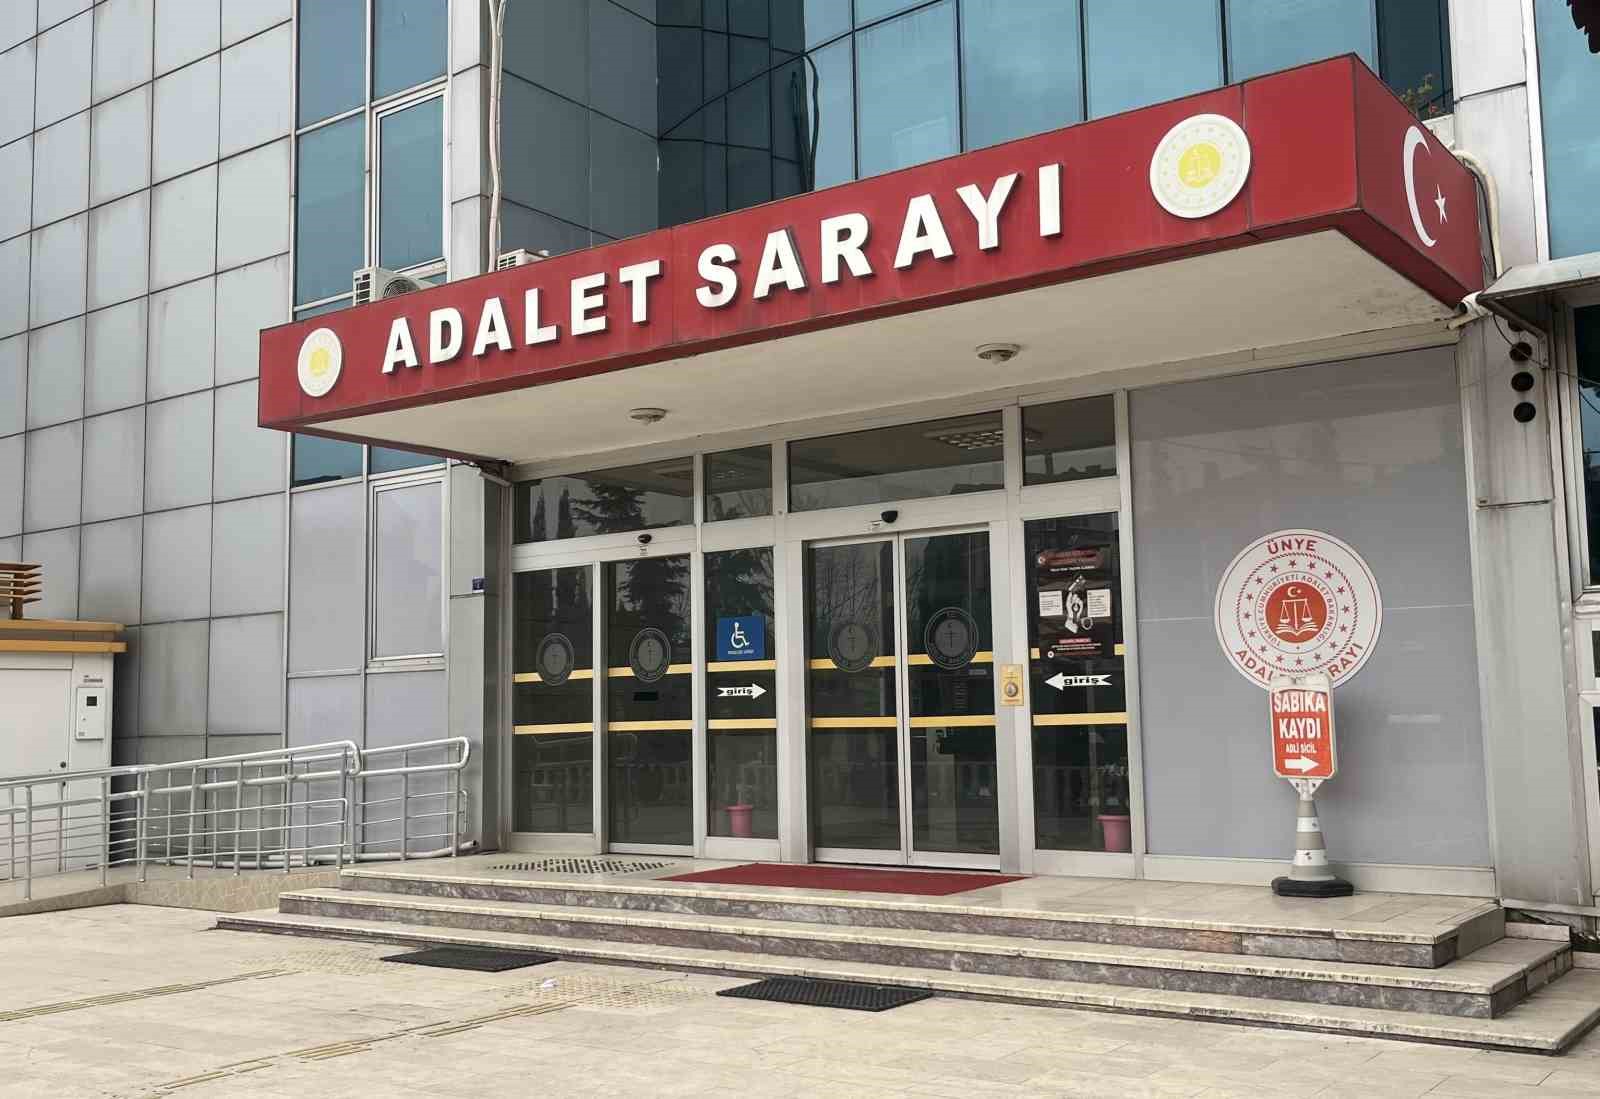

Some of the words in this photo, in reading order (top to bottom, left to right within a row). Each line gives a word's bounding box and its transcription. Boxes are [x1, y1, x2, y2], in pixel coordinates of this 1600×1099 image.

[381, 258, 663, 374] ADALET
[695, 163, 1063, 310] SARAYI
[1267, 537, 1318, 555] ÜNYE
[1235, 649, 1274, 681] ADAL
[1327, 642, 1364, 678] RAYI
[1063, 675, 1102, 687] giriş
[1274, 693, 1326, 713] SABIKA
[1279, 718, 1321, 740] KAYDI
